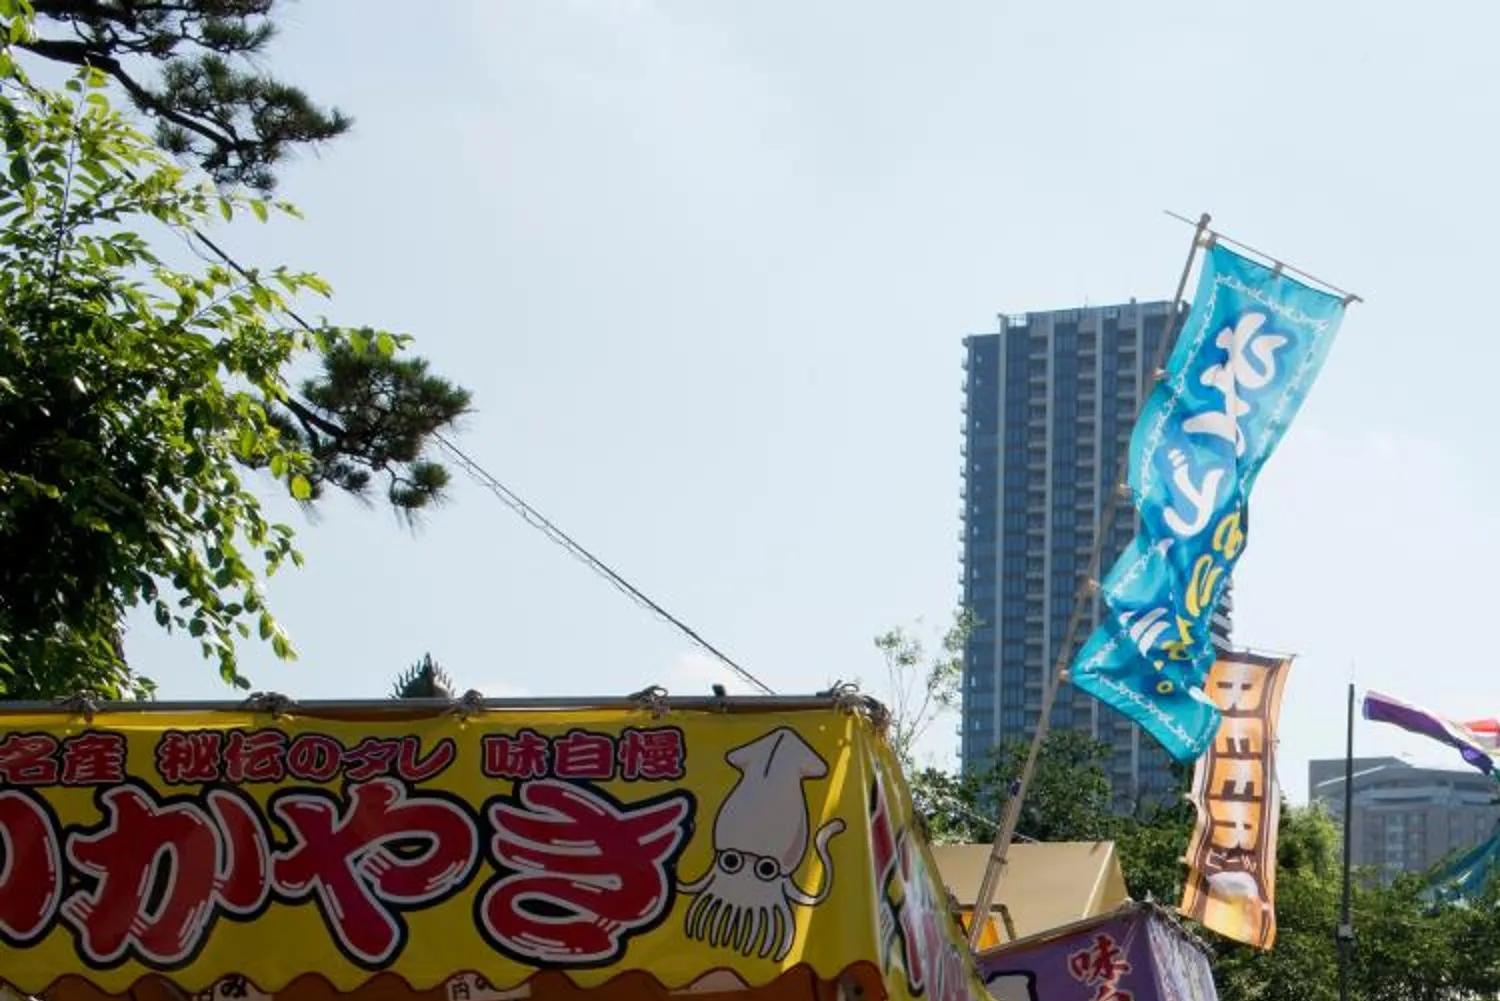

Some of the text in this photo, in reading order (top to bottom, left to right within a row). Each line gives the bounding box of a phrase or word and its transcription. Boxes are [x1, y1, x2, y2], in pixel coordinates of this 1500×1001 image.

[0, 727, 687, 783] 名産 秘伝のタレ 味自慢
